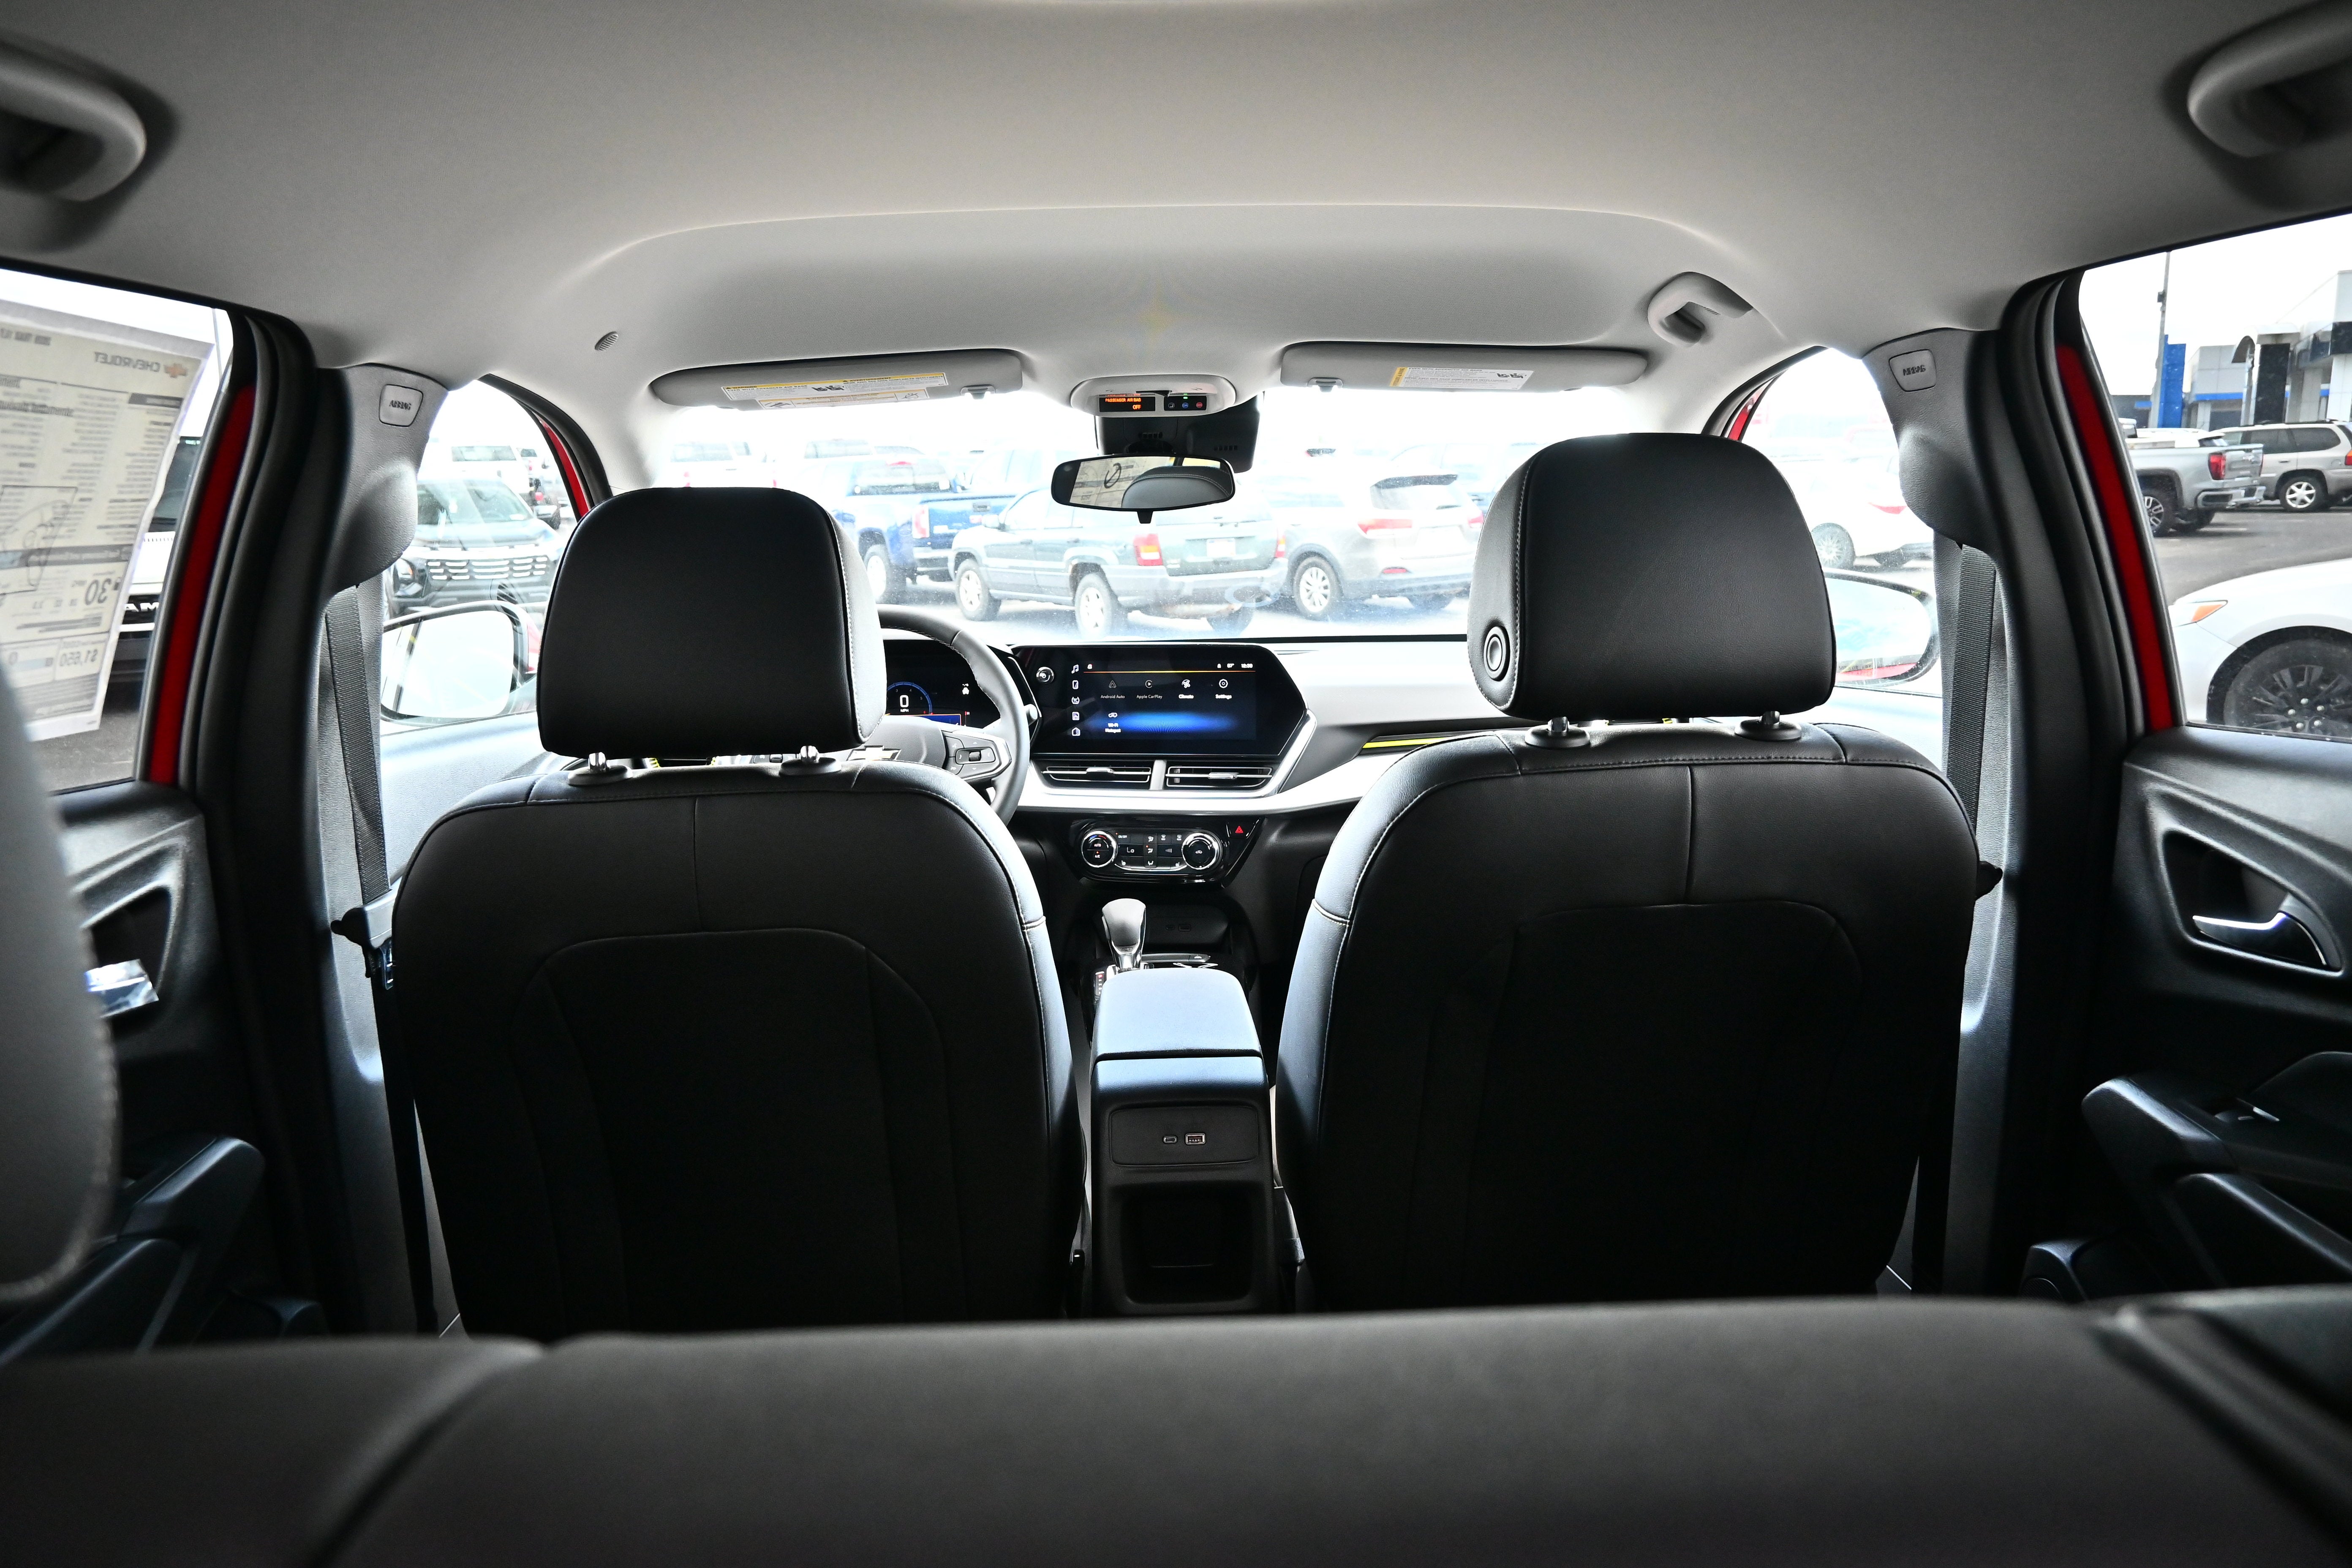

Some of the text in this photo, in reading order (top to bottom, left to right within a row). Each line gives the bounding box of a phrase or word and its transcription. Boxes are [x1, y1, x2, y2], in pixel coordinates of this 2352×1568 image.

[1903, 365, 1926, 376] AIRBAG
[389, 400, 412, 411] AIRBAG
[125, 602, 159, 612] AM
[900, 695, 909, 708] 0
